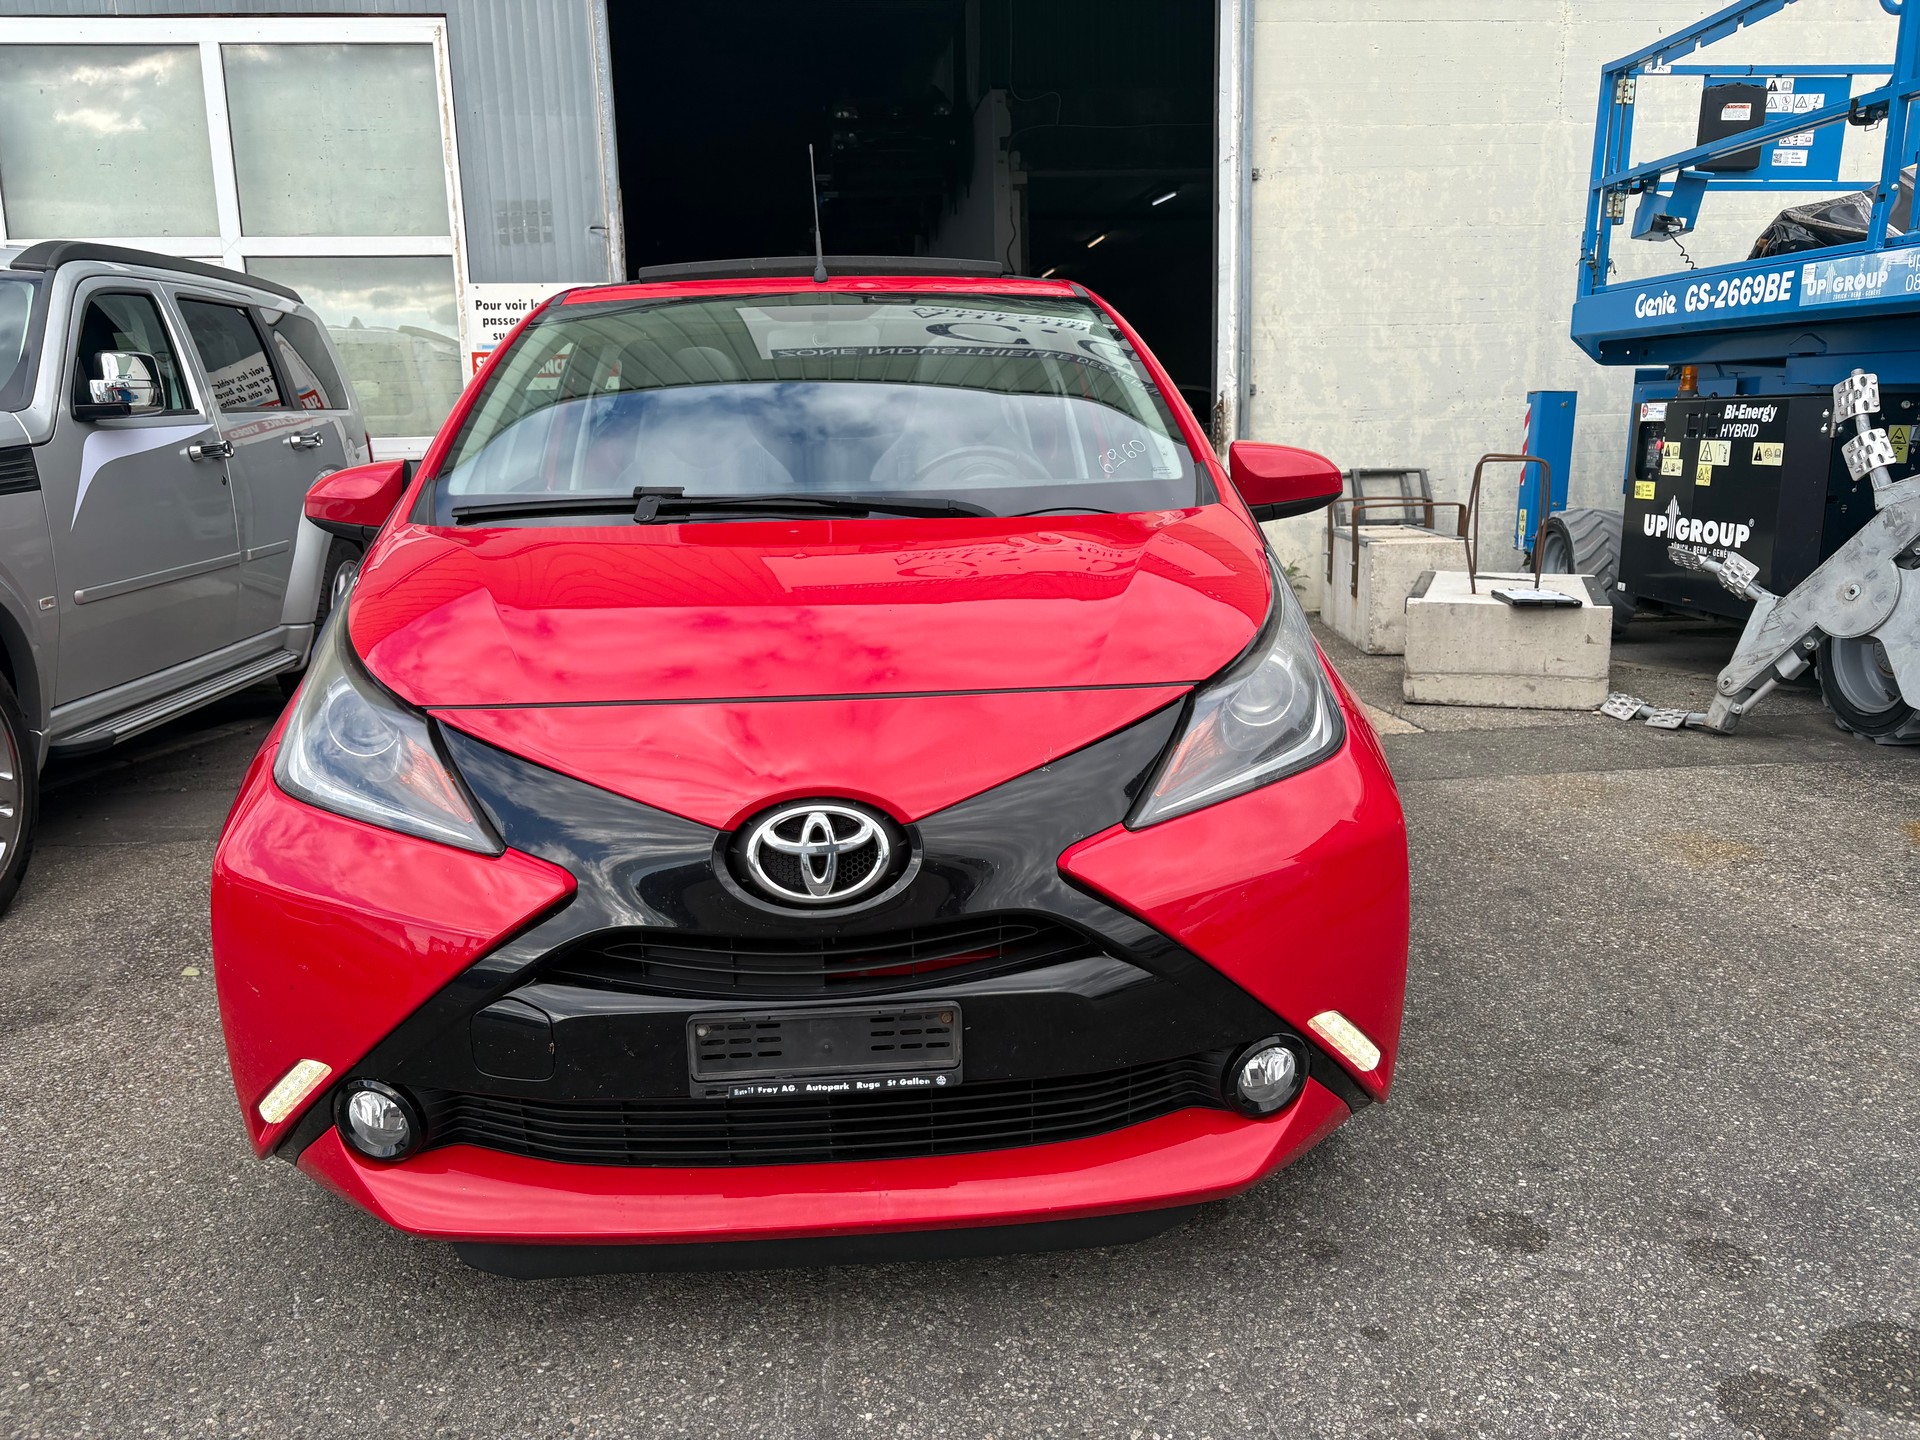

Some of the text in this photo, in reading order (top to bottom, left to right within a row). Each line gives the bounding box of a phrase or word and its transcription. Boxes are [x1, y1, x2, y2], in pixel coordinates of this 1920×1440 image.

[1807, 279, 1827, 296] UP
[1832, 270, 1889, 293] GROUP
[1635, 289, 1677, 318] Genie
[1684, 270, 1795, 313] GS-2669BE
[475, 299, 502, 311] Pour
[505, 299, 527, 310] voir
[483, 317, 521, 328] passer
[493, 332, 508, 341] su
[1724, 404, 1778, 423] Bi-Energy
[1720, 423, 1760, 438] HYBRID
[1643, 513, 1750, 548] UP GROUP
[757, 1086, 779, 1096] Frey
[805, 1082, 850, 1093] Autopark
[900, 1077, 931, 1086] Gallen
